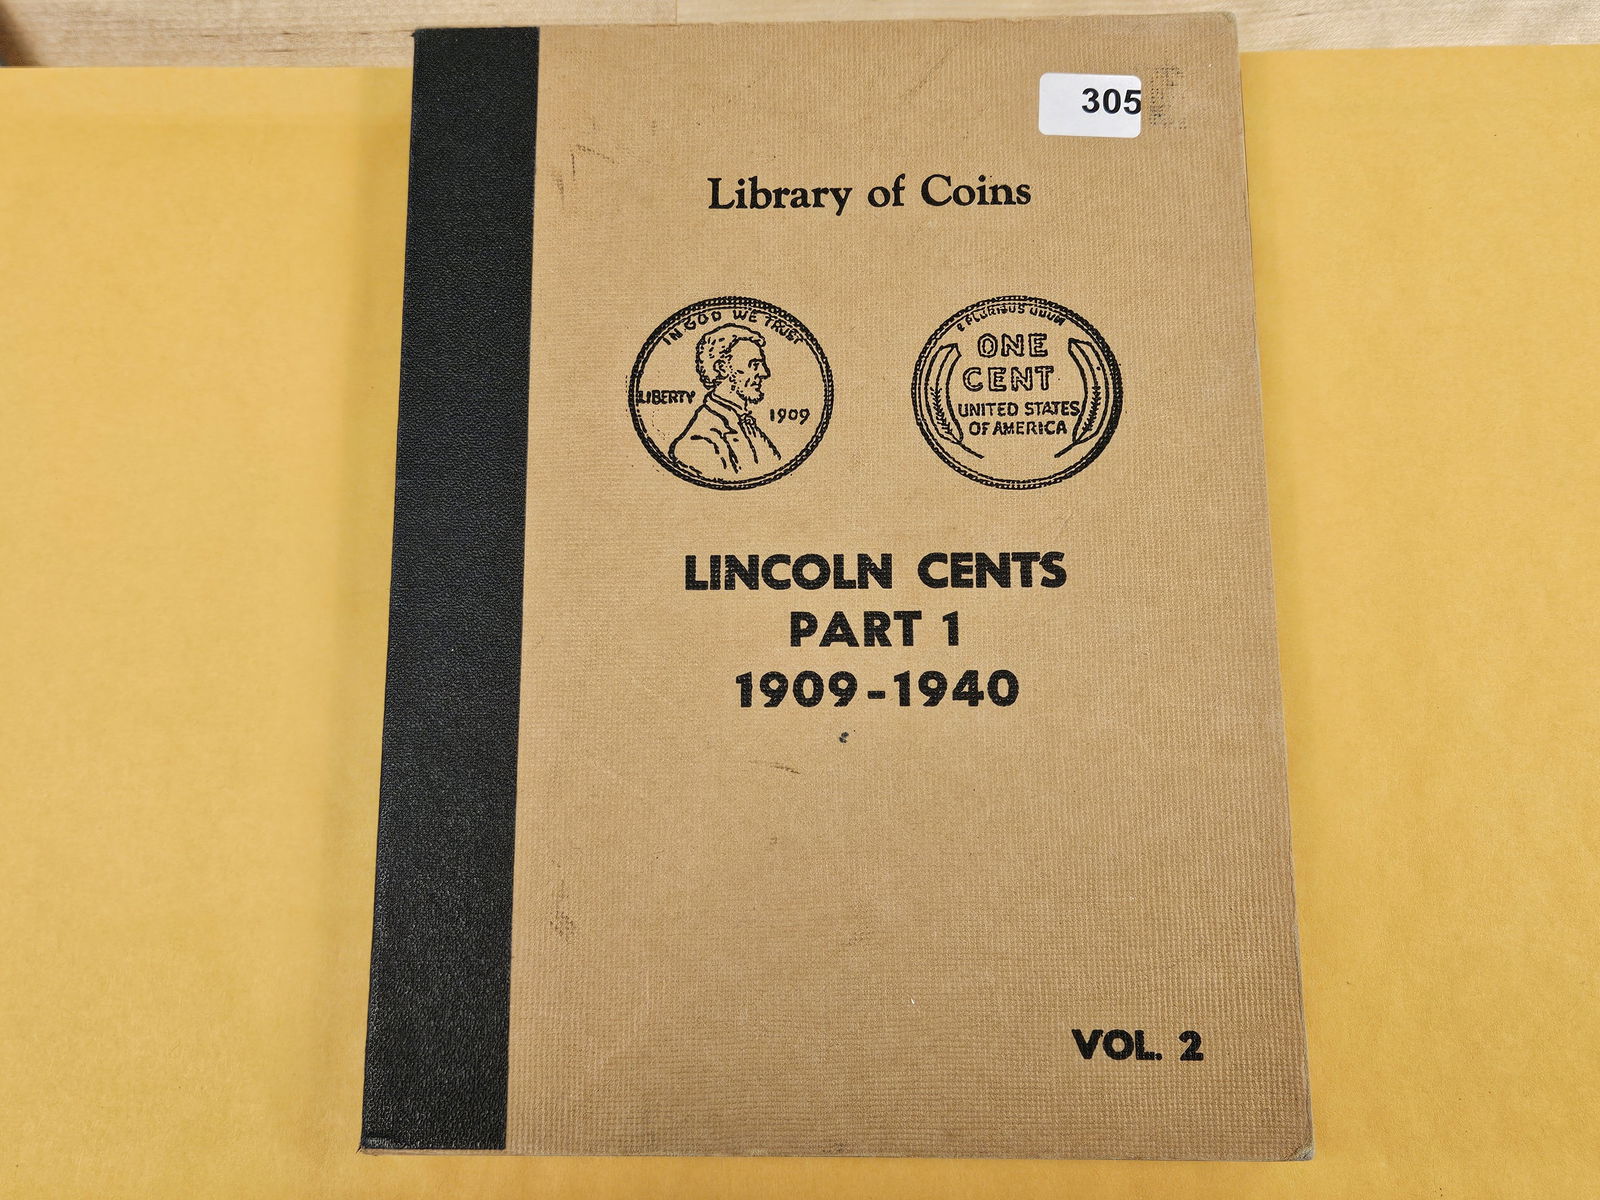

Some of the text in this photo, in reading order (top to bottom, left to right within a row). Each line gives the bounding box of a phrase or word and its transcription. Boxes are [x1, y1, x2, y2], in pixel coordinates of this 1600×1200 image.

[1081, 87, 1141, 115] 305
[708, 173, 1032, 216] Library of Coins
[661, 308, 804, 346] IN GOD WE TRUST
[977, 332, 1049, 359] ONE
[962, 365, 1055, 393] CENT
[637, 389, 696, 405] LIBERTY
[957, 400, 1081, 418] UNITED STATES
[769, 407, 811, 426] 1909
[968, 420, 1068, 436] OF AMERICA
[684, 551, 1068, 591] LINCOLN CENTS
[790, 610, 959, 648] PART 1
[735, 669, 1020, 708] 1909-1940
[1071, 1028, 1204, 1062] VOL. 2
